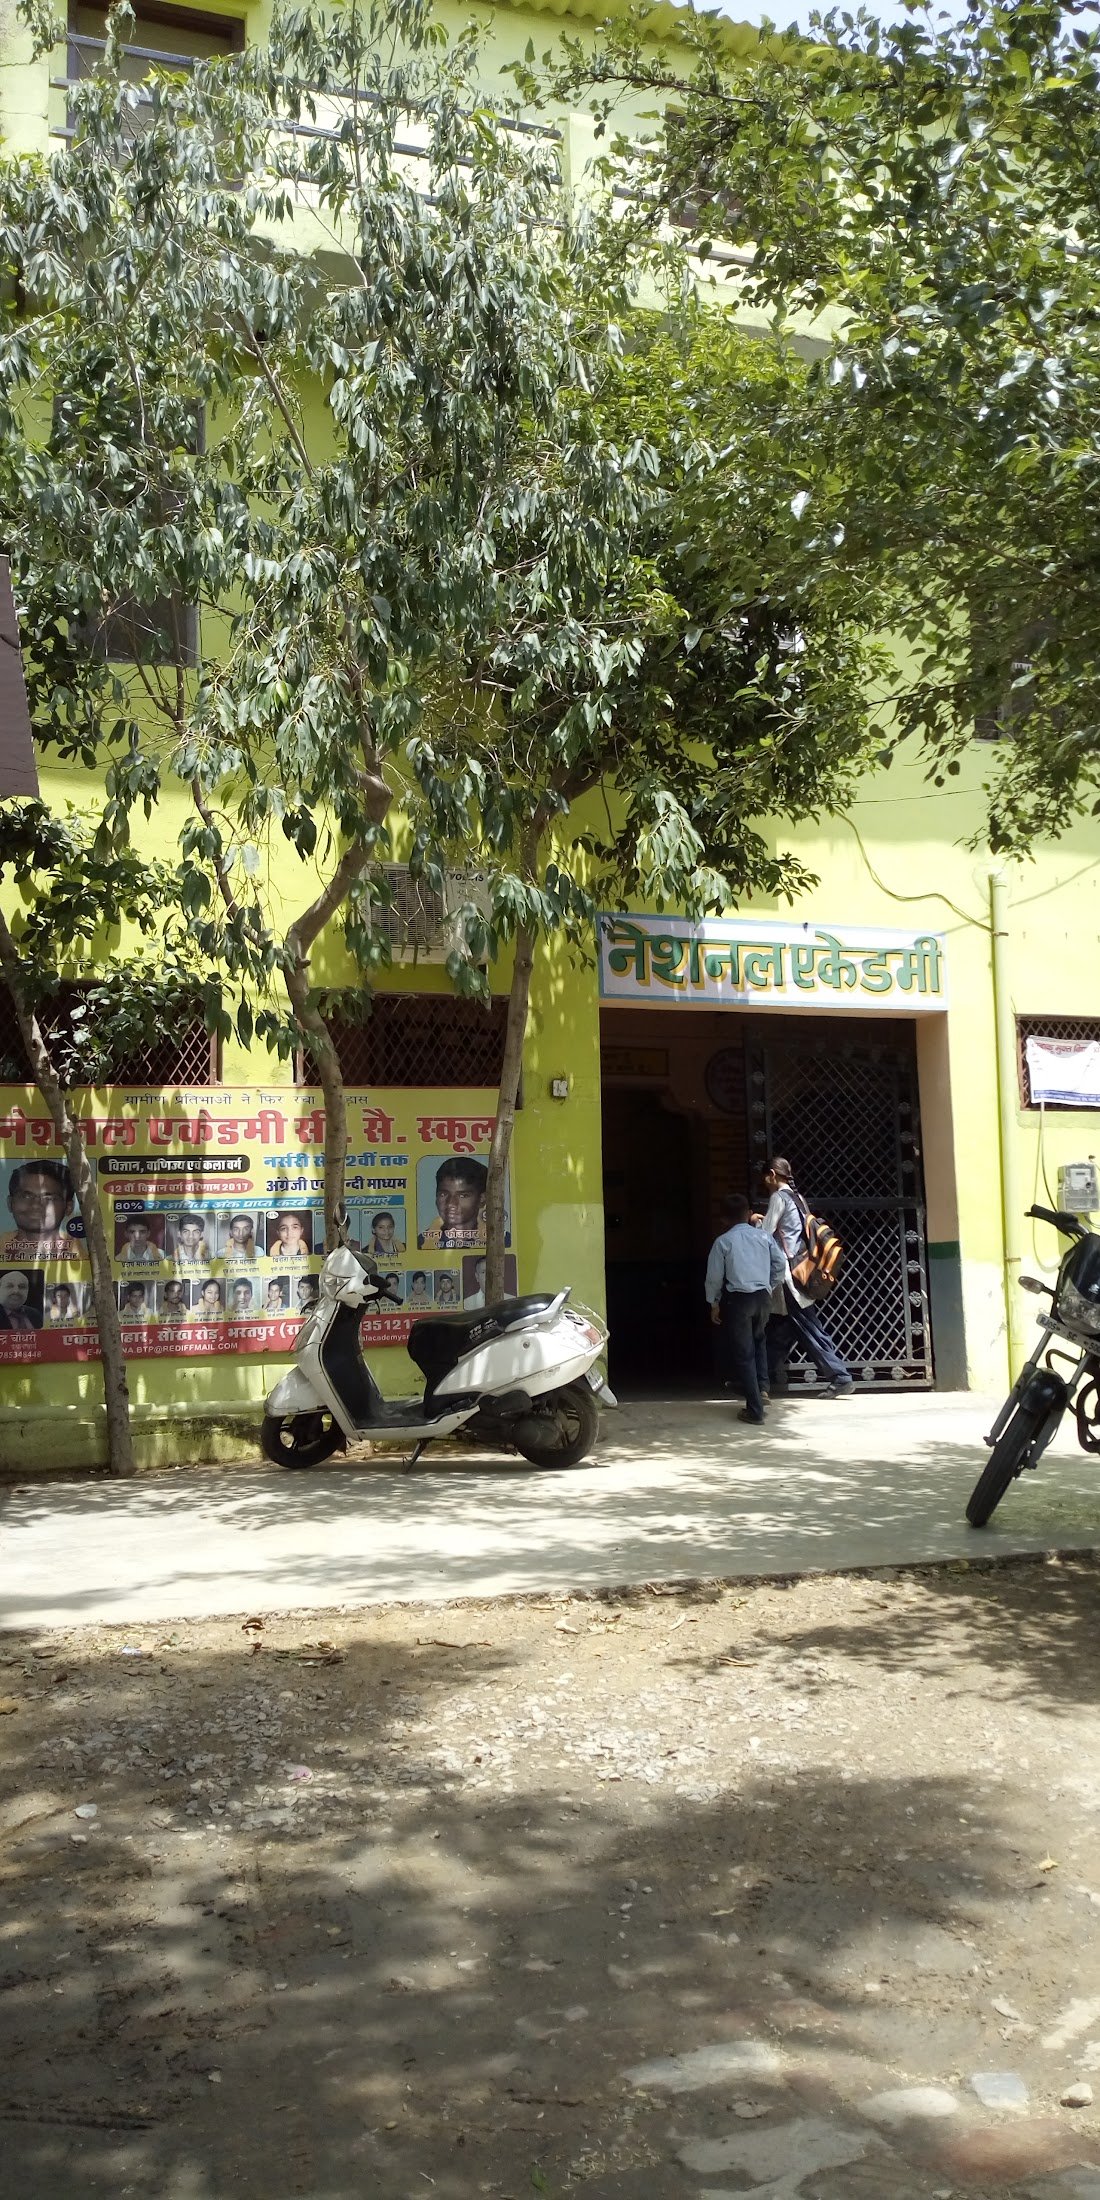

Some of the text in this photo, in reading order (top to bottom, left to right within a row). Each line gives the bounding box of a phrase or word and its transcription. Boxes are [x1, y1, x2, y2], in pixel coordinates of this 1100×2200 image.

[607, 919, 944, 993] नेशनल एकेडमी
[124, 1094, 165, 1105] ग्रामीण
[241, 1094, 250, 1104] ने
[260, 1095, 282, 1105] फिर
[0, 1108, 140, 1147] नेशनल
[146, 1109, 288, 1146] एकेडमी
[362, 1108, 407, 1144] सै.
[416, 1116, 500, 1153] स्कूल
[108, 1158, 145, 1173] विज्ञान,
[146, 1158, 185, 1172] वाणिज्य
[264, 1153, 309, 1168] नर्सरी
[345, 1152, 377, 1167] 2वीं
[379, 1154, 409, 1167] तक
[109, 1185, 121, 1193] 12
[138, 1183, 167, 1192] विज्ञान
[169, 1182, 182, 1192] वर्ग
[185, 1182, 221, 1191] परिणाम
[222, 1183, 249, 1191] 2017
[266, 1177, 308, 1192] अंग्रेजी
[366, 1177, 407, 1190] माध्यम
[115, 1202, 142, 1210] 80%
[69, 1222, 83, 1232] 95
[62, 1333, 99, 1346] एकत
[121, 1331, 153, 1344] हार,
[228, 1323, 275, 1342] भरतपुर
